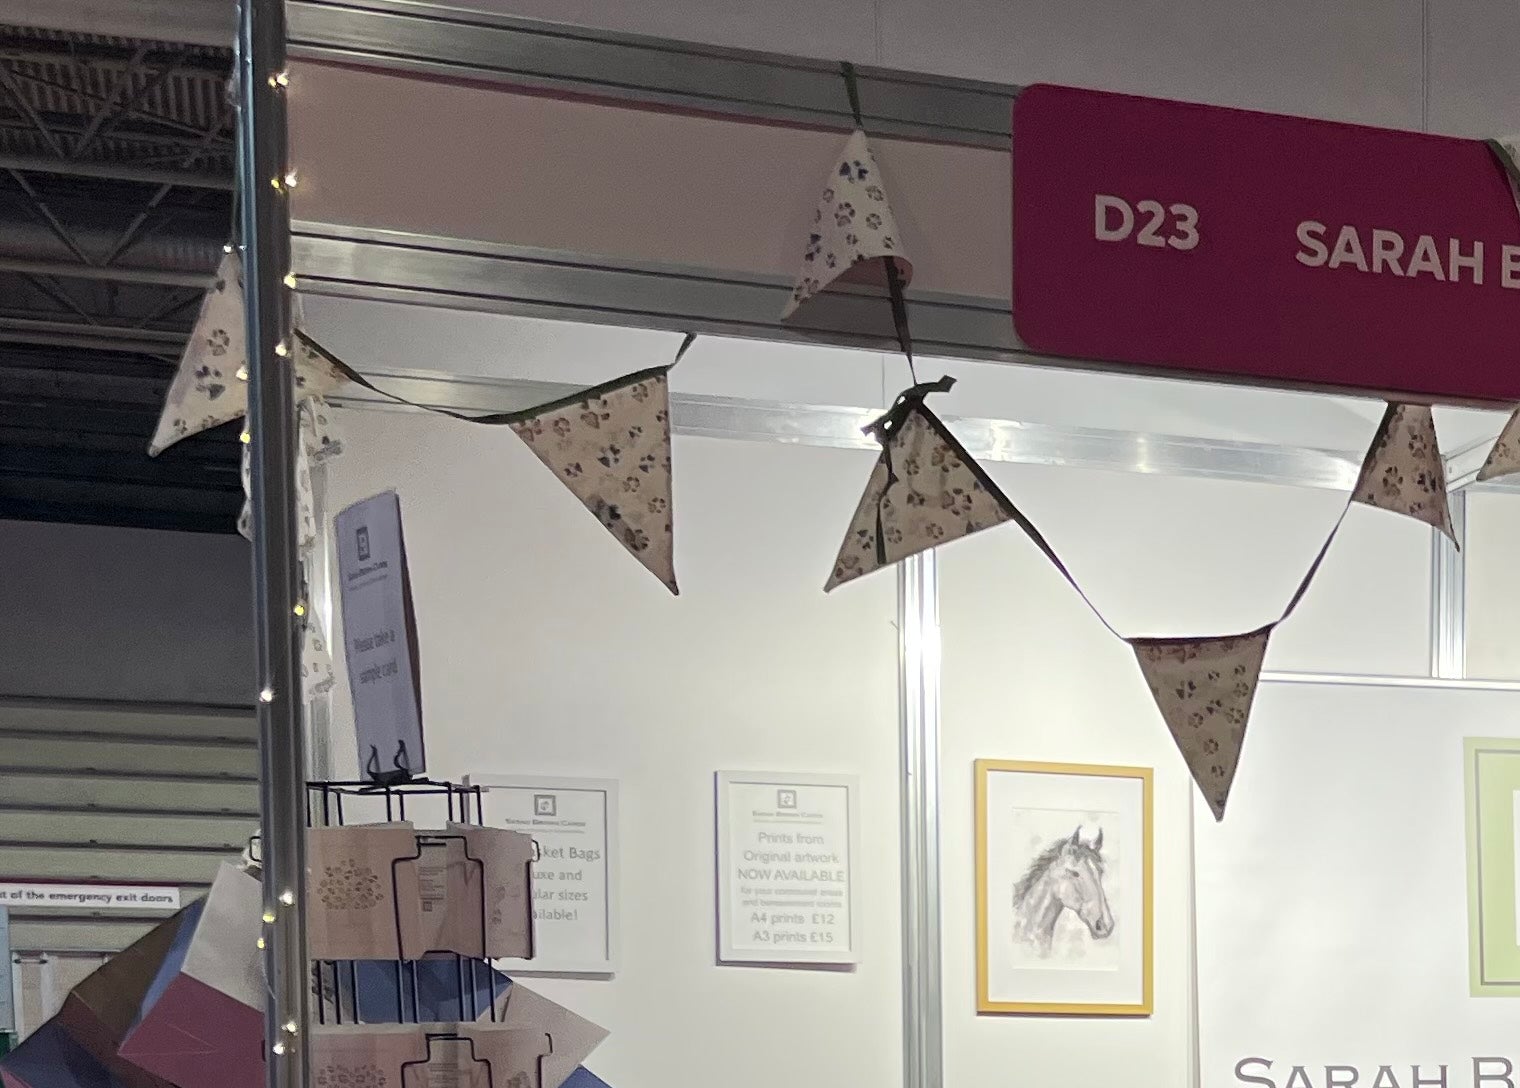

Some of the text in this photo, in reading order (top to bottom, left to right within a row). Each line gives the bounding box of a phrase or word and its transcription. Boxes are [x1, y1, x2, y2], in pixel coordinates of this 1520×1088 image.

[1095, 194, 1200, 251] D23
[1295, 221, 1484, 285] SARAH
[758, 832, 824, 844] Prints from
[540, 846, 601, 862] ket Bags
[744, 850, 839, 864] Original artwork
[532, 869, 583, 881] uxe and
[738, 868, 845, 882] NOW AVAILABLE
[11, 890, 23, 900] of
[26, 890, 45, 900] the
[49, 893, 112, 904] emergency
[116, 892, 137, 902] exit
[141, 892, 173, 903] doors
[558, 889, 588, 901] sizes
[532, 909, 578, 921] ailable!
[751, 912, 767, 923] A4
[771, 912, 805, 925] prints
[753, 930, 770, 942] A3
[773, 930, 807, 944] prints
